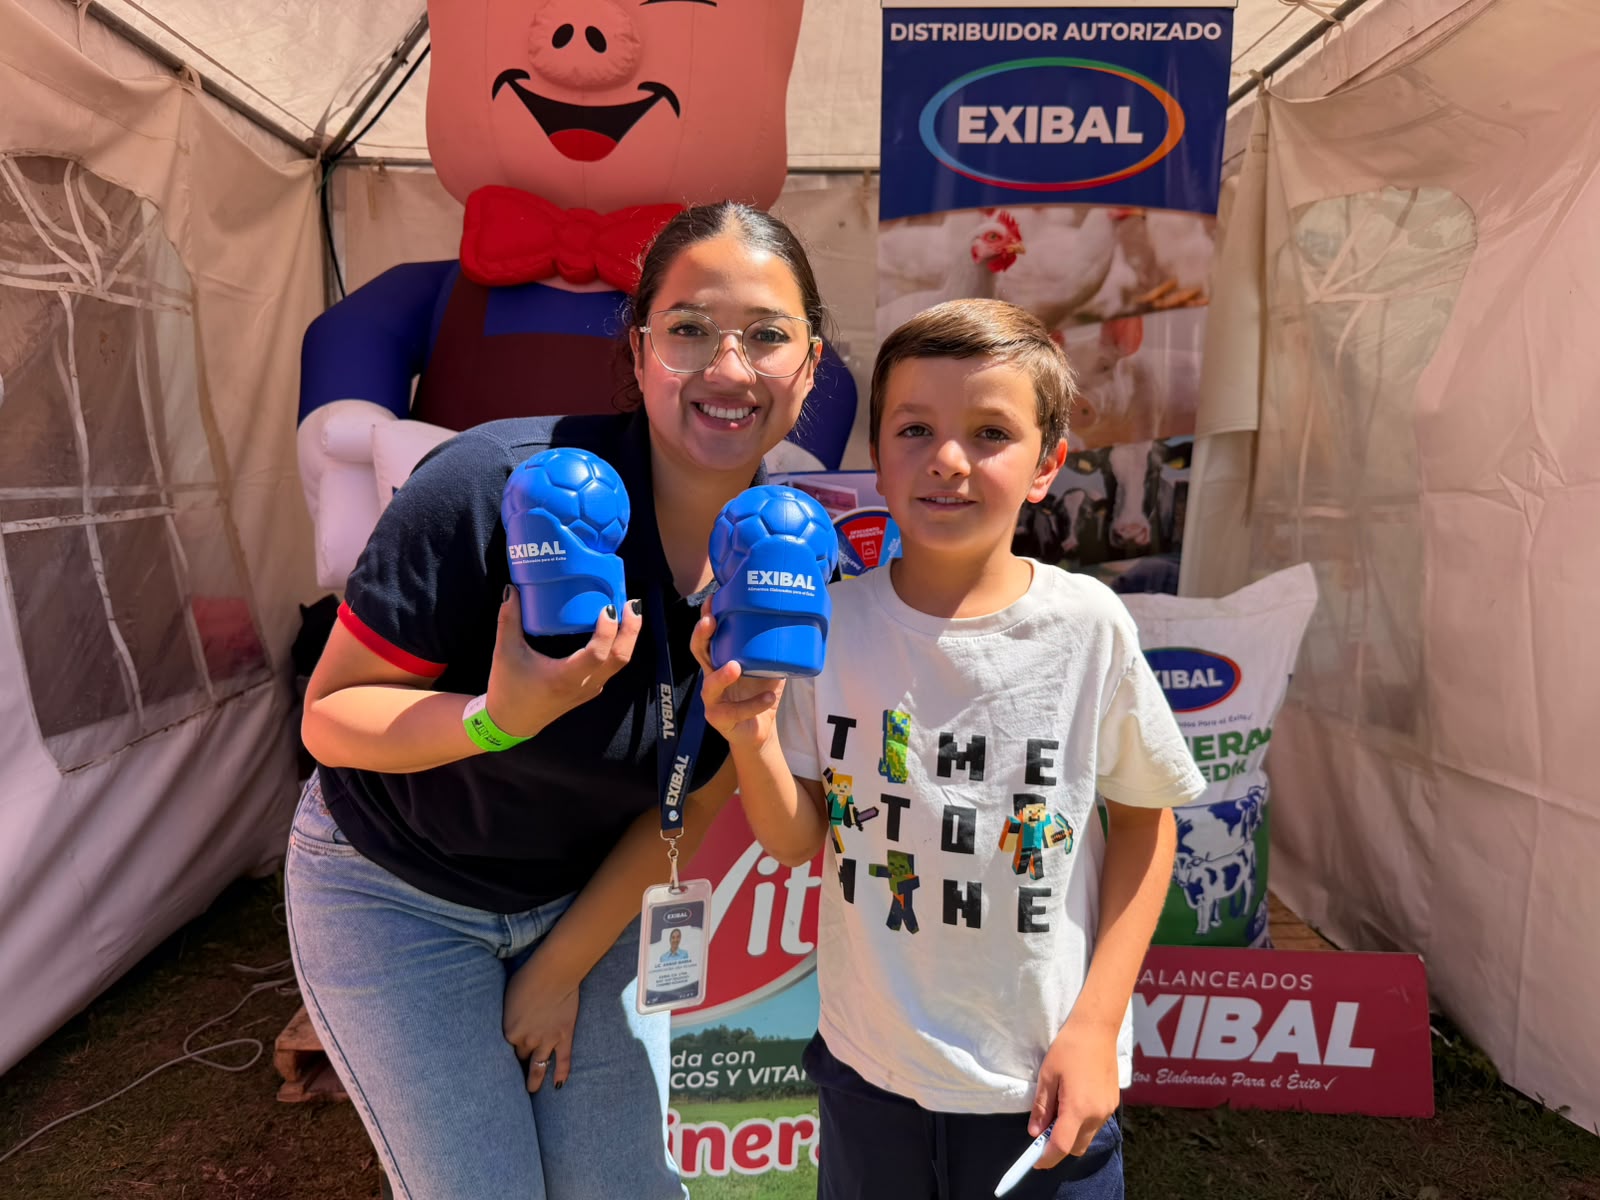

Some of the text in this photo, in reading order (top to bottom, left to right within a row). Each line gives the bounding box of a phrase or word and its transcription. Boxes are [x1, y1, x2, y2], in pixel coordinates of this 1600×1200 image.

[890, 22, 1222, 41] DISTRIBUIDOR AUTORIZADO
[957, 106, 1143, 144] EXIBAL
[508, 541, 566, 559] EXIBAL
[747, 570, 816, 591] EXIBAL
[660, 683, 675, 739] EXIBAL
[1185, 727, 1272, 762] ERA
[665, 755, 690, 806] EXIBAL
[1138, 969, 1313, 990] ALANCEADOS
[671, 1050, 756, 1068] da con
[670, 1070, 719, 1089] COS
[726, 1069, 743, 1087] Y
[1155, 1068, 1227, 1085] Elaborados
[1231, 1072, 1266, 1087] Para
[1270, 1074, 1283, 1088] el
[667, 1112, 820, 1176] iner
